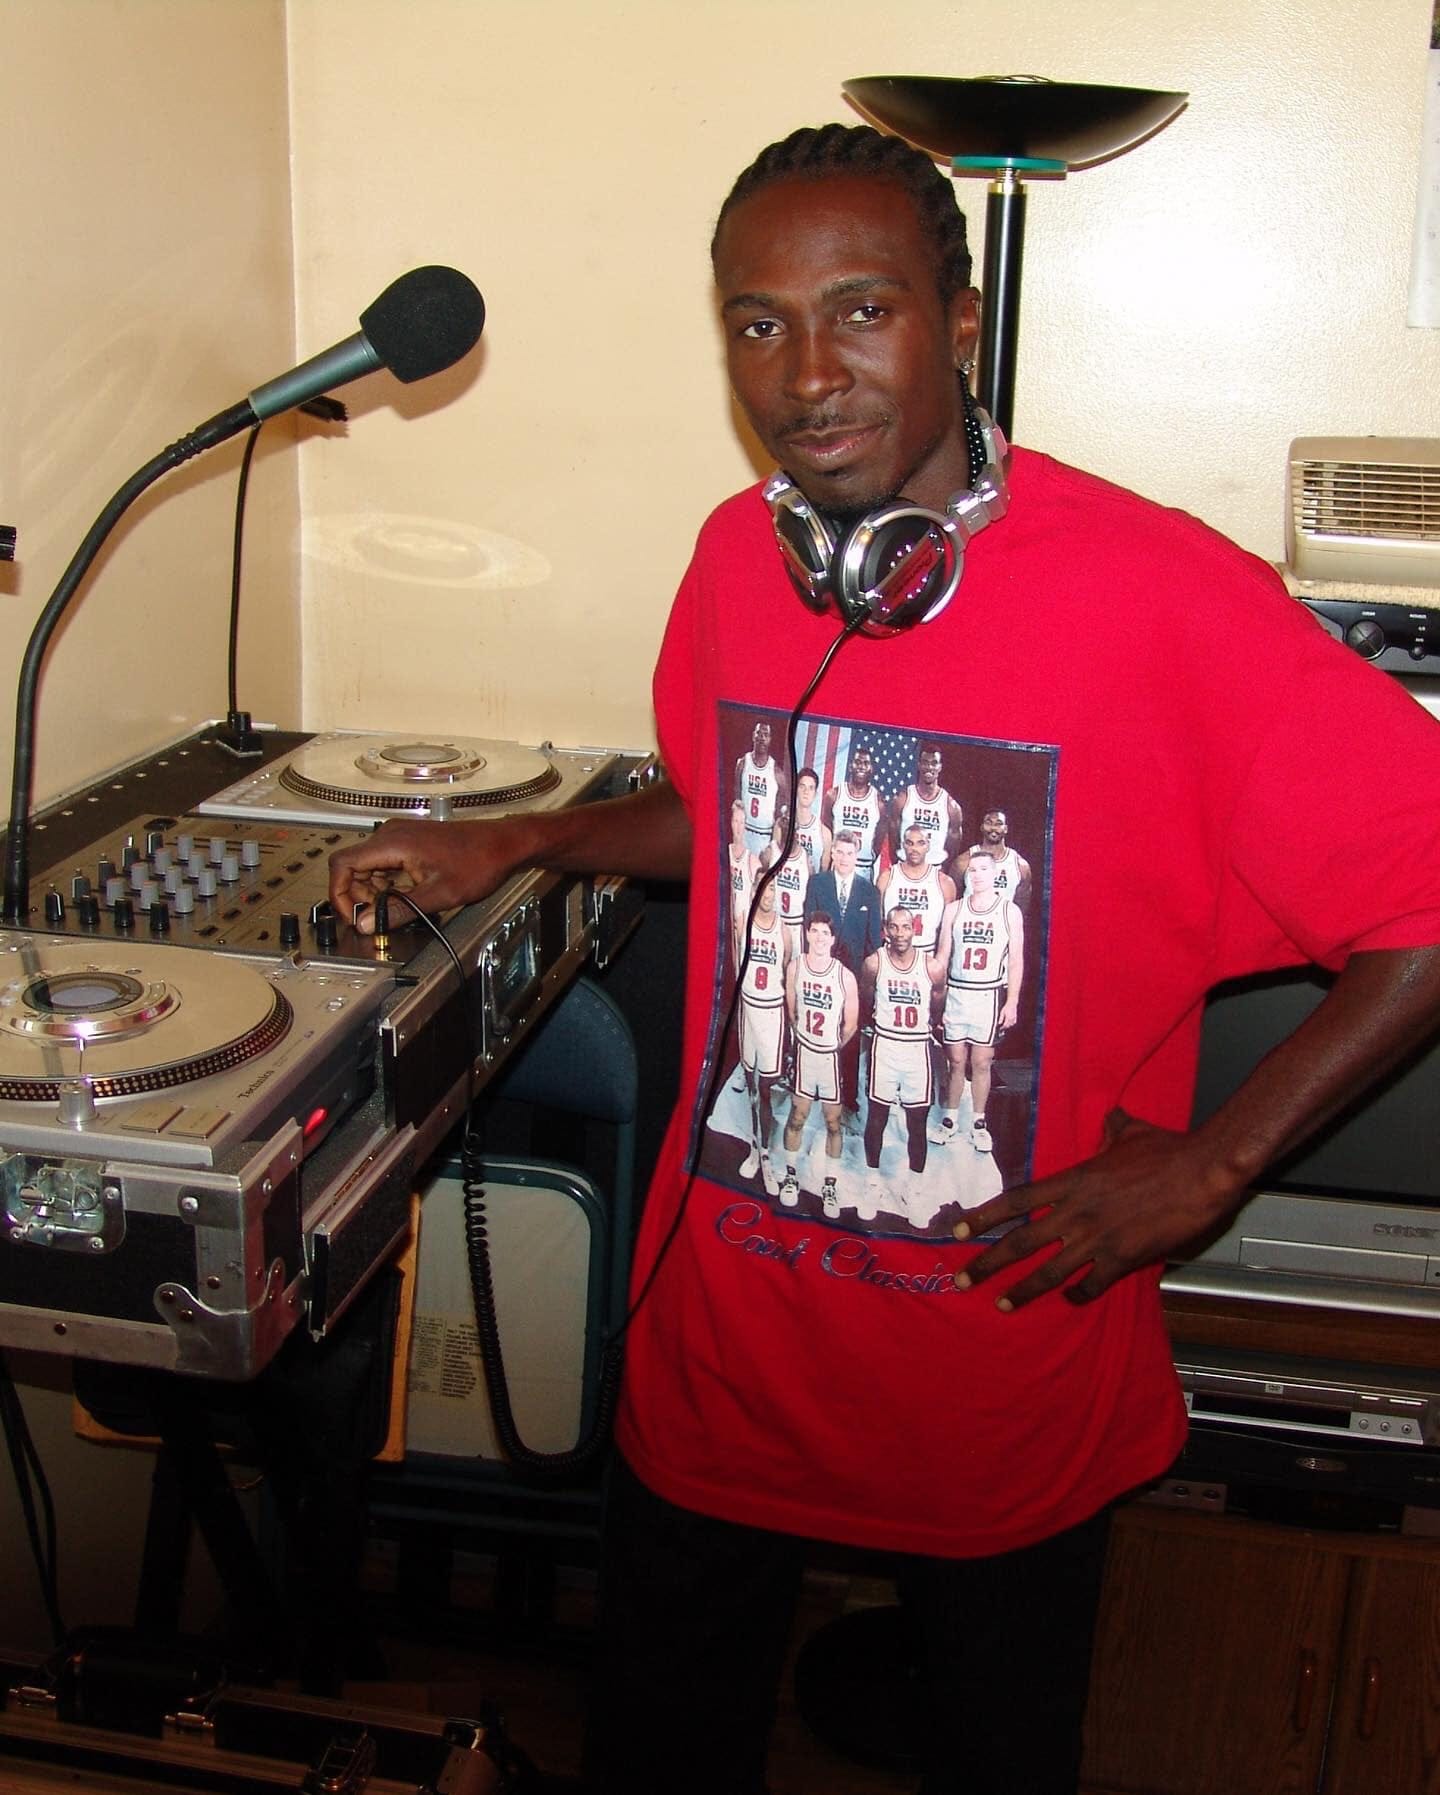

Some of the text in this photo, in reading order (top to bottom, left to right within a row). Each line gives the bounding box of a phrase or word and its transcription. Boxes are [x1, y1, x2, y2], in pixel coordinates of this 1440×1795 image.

[748, 774, 768, 790] USA
[750, 798, 760, 818] 6
[843, 806, 869, 822] USA
[914, 808, 940, 824] USA
[778, 865, 800, 883] SA
[781, 891, 790, 913] 9
[899, 888, 928, 902] USA
[963, 921, 994, 937] USA
[750, 939, 777, 958] USA
[963, 948, 988, 970] 13
[755, 966, 768, 990] 8
[803, 981, 832, 1000] USA
[888, 980, 921, 997] USA
[806, 1010, 825, 1037] 12
[893, 1005, 918, 1028] 10
